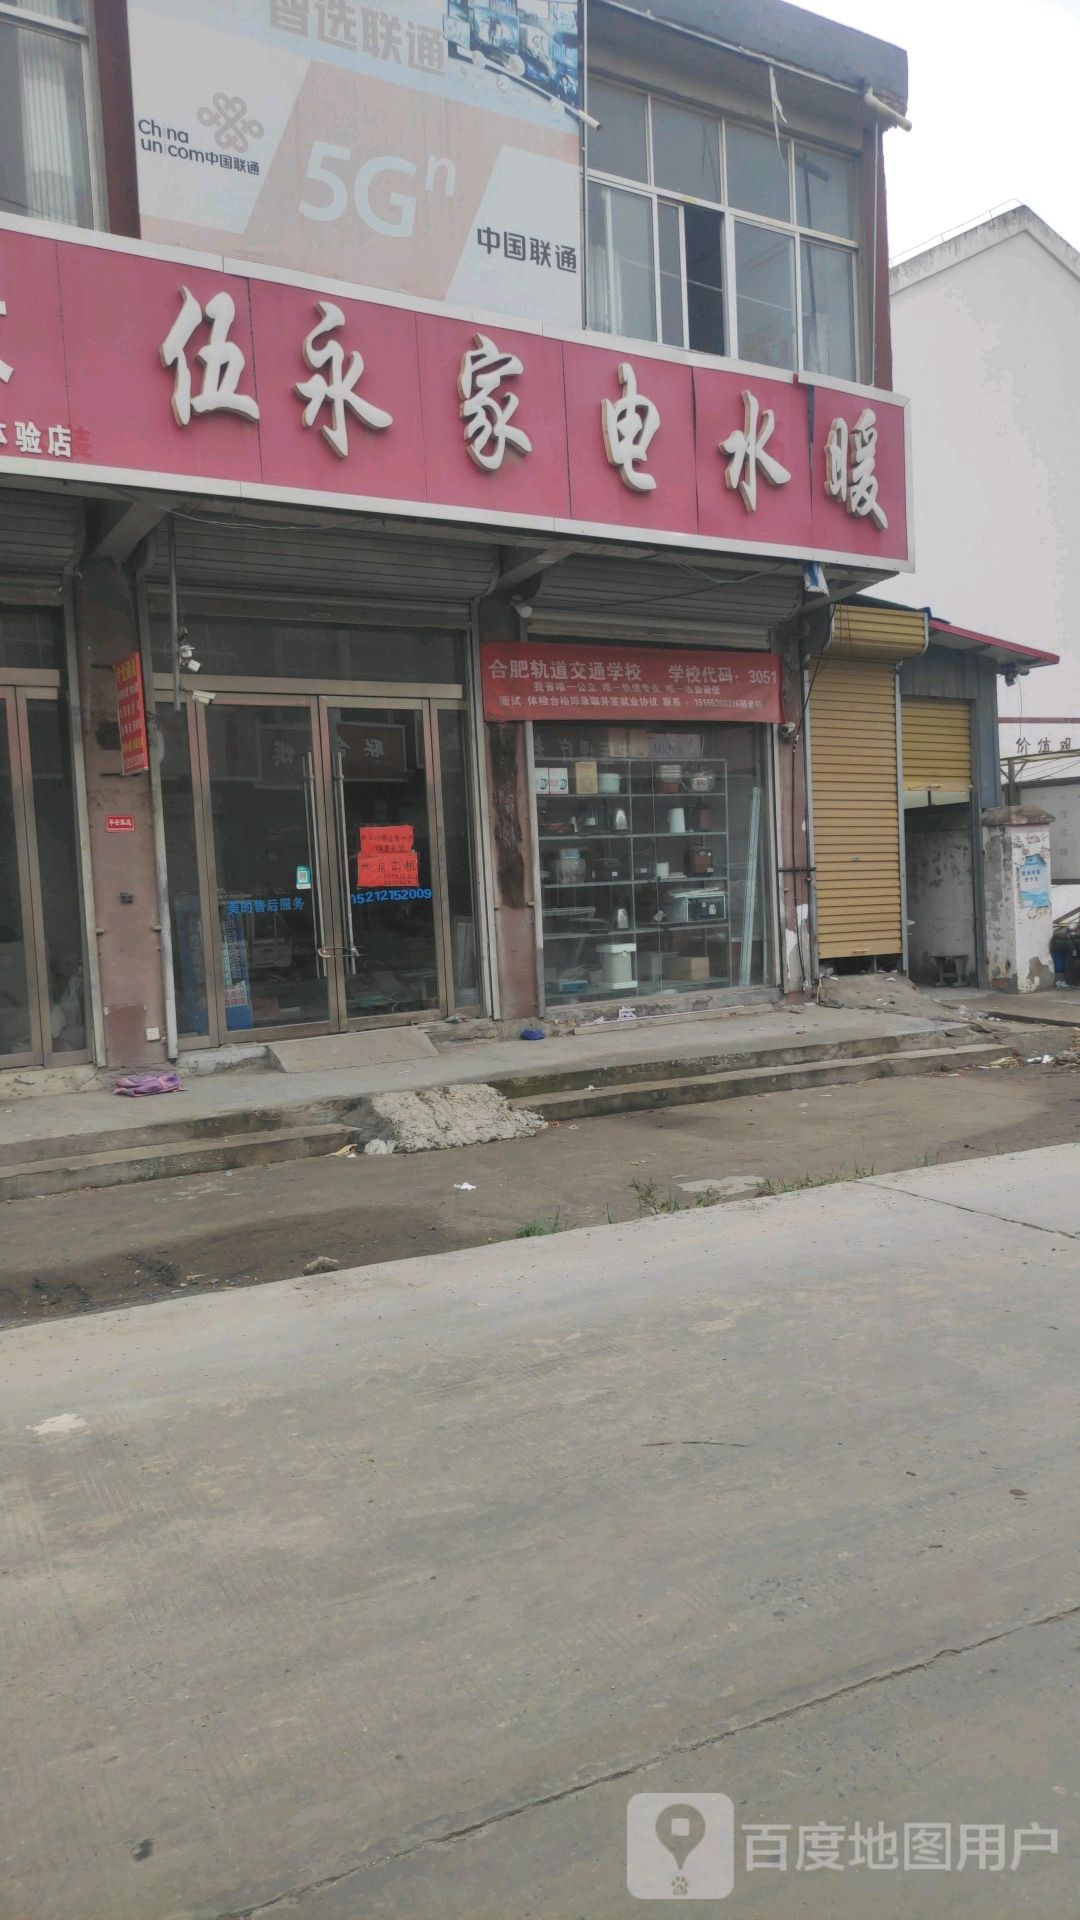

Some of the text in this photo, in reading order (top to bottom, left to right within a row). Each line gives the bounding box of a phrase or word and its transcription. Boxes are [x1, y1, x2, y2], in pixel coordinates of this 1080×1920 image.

[476, 226, 578, 274] 中国联通
[159, 284, 889, 531] 伍永家电水暖
[488, 659, 642, 682] 合肥轨道交通学校
[748, 669, 777, 685] 3051
[227, 896, 305, 914] 美的售后服务
